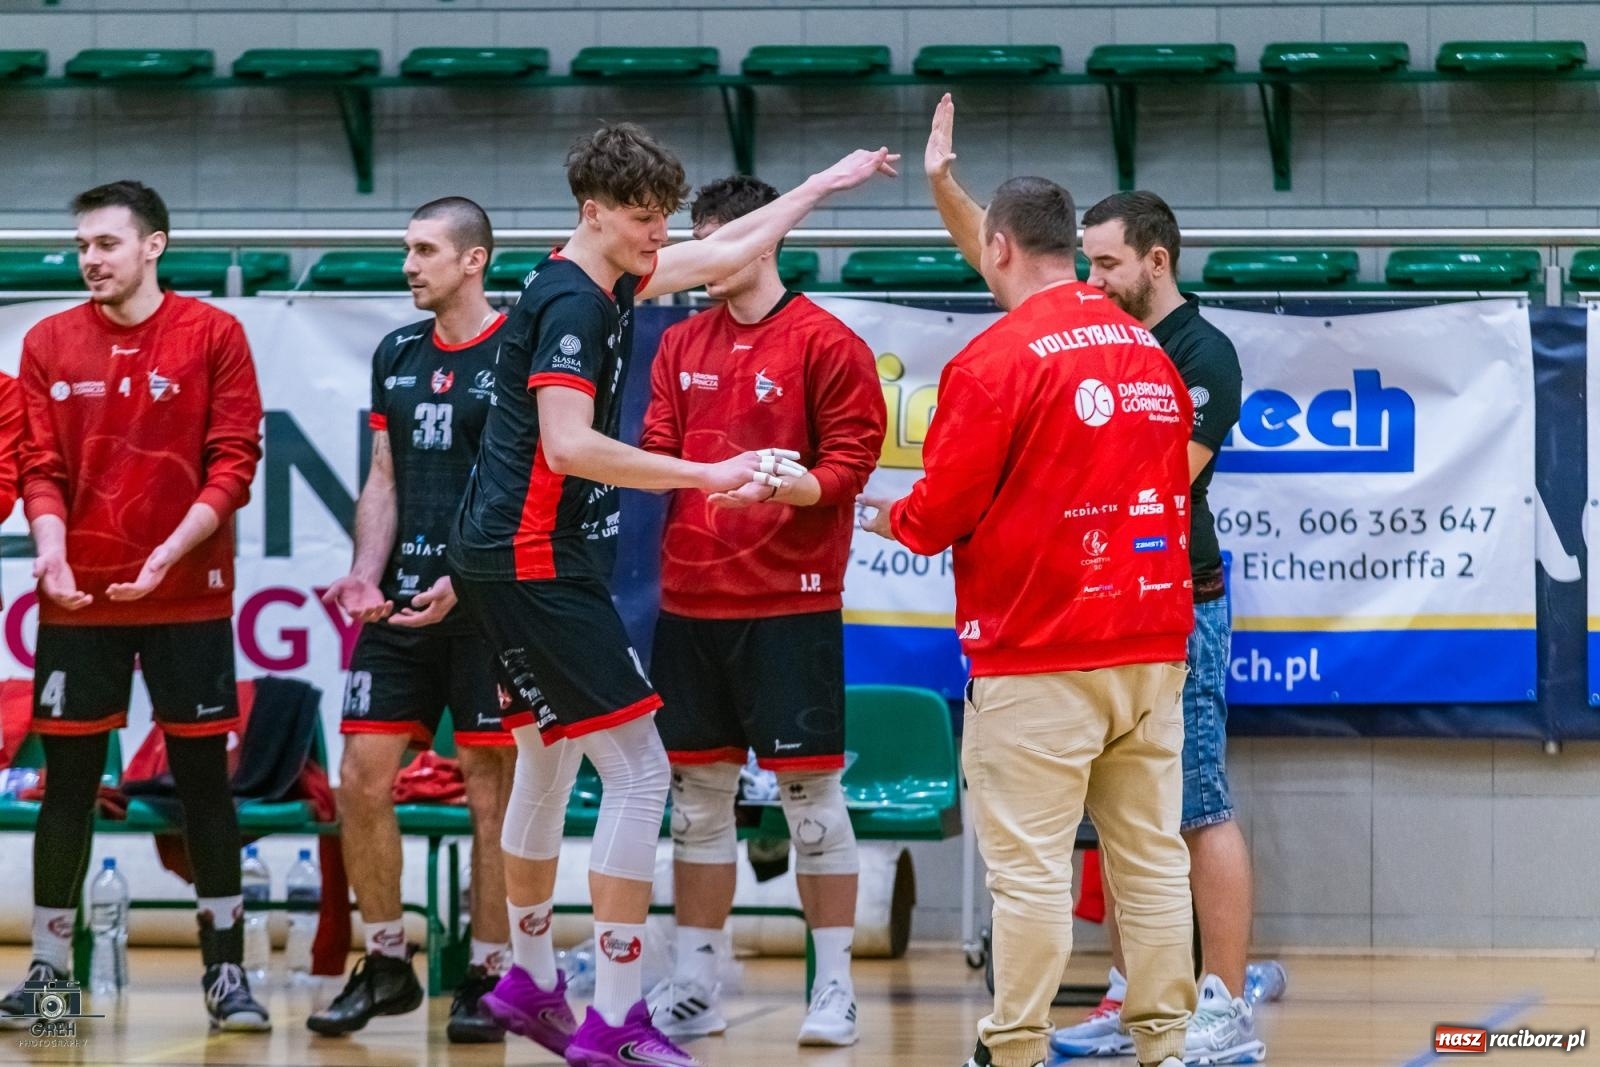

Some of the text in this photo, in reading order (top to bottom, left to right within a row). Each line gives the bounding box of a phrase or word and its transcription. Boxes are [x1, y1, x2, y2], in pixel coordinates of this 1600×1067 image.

[1028, 323, 1162, 358] VOLLEYBALL TEA
[118, 376, 131, 397] 4
[412, 402, 454, 451] 33
[1222, 369, 1416, 473] ech
[1216, 505, 1497, 538] 695, 606 363 647
[849, 550, 930, 578] -400
[1243, 550, 1475, 581] Eichendorffa 2
[1228, 647, 1321, 691] ch.pl
[39, 670, 67, 717] 4
